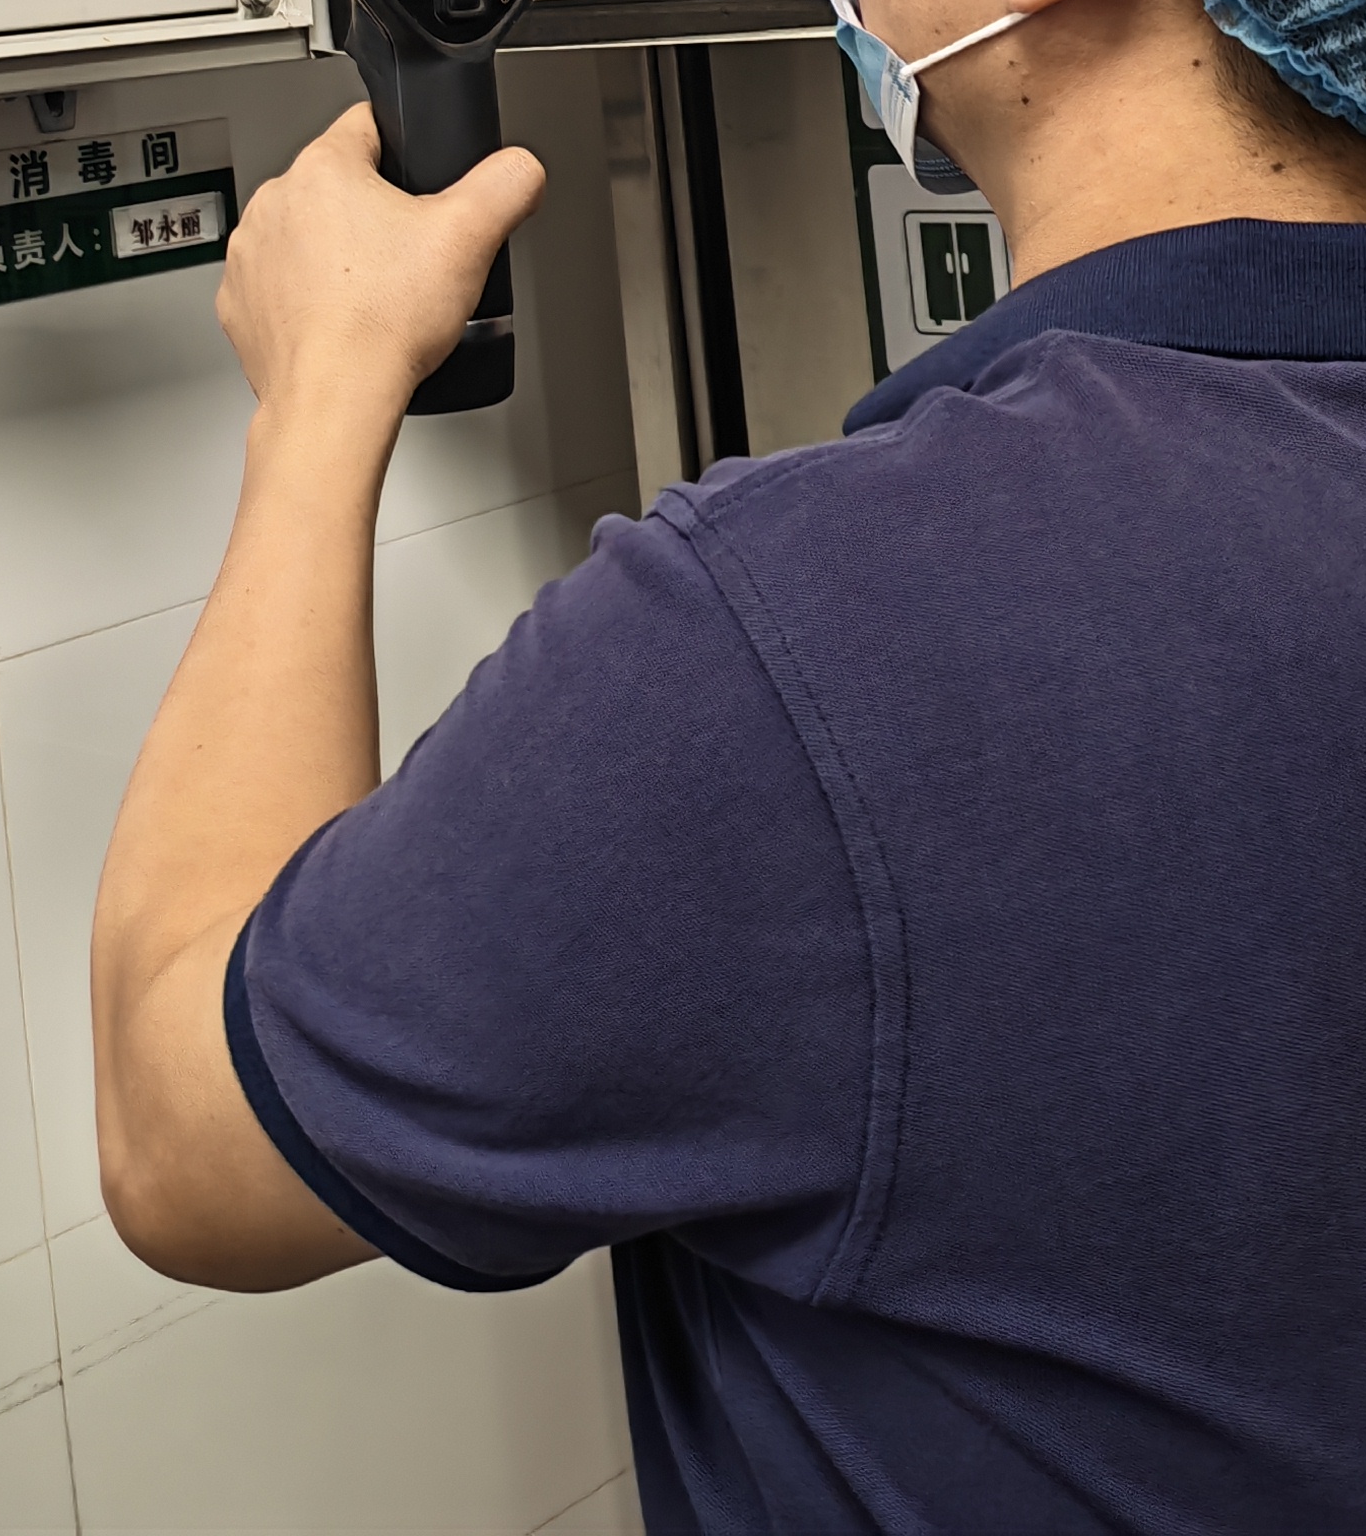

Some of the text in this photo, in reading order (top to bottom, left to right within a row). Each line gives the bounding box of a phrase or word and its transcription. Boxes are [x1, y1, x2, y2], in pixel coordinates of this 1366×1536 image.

[10, 131, 179, 199] 消毒间
[131, 209, 201, 246] 邹永丽
